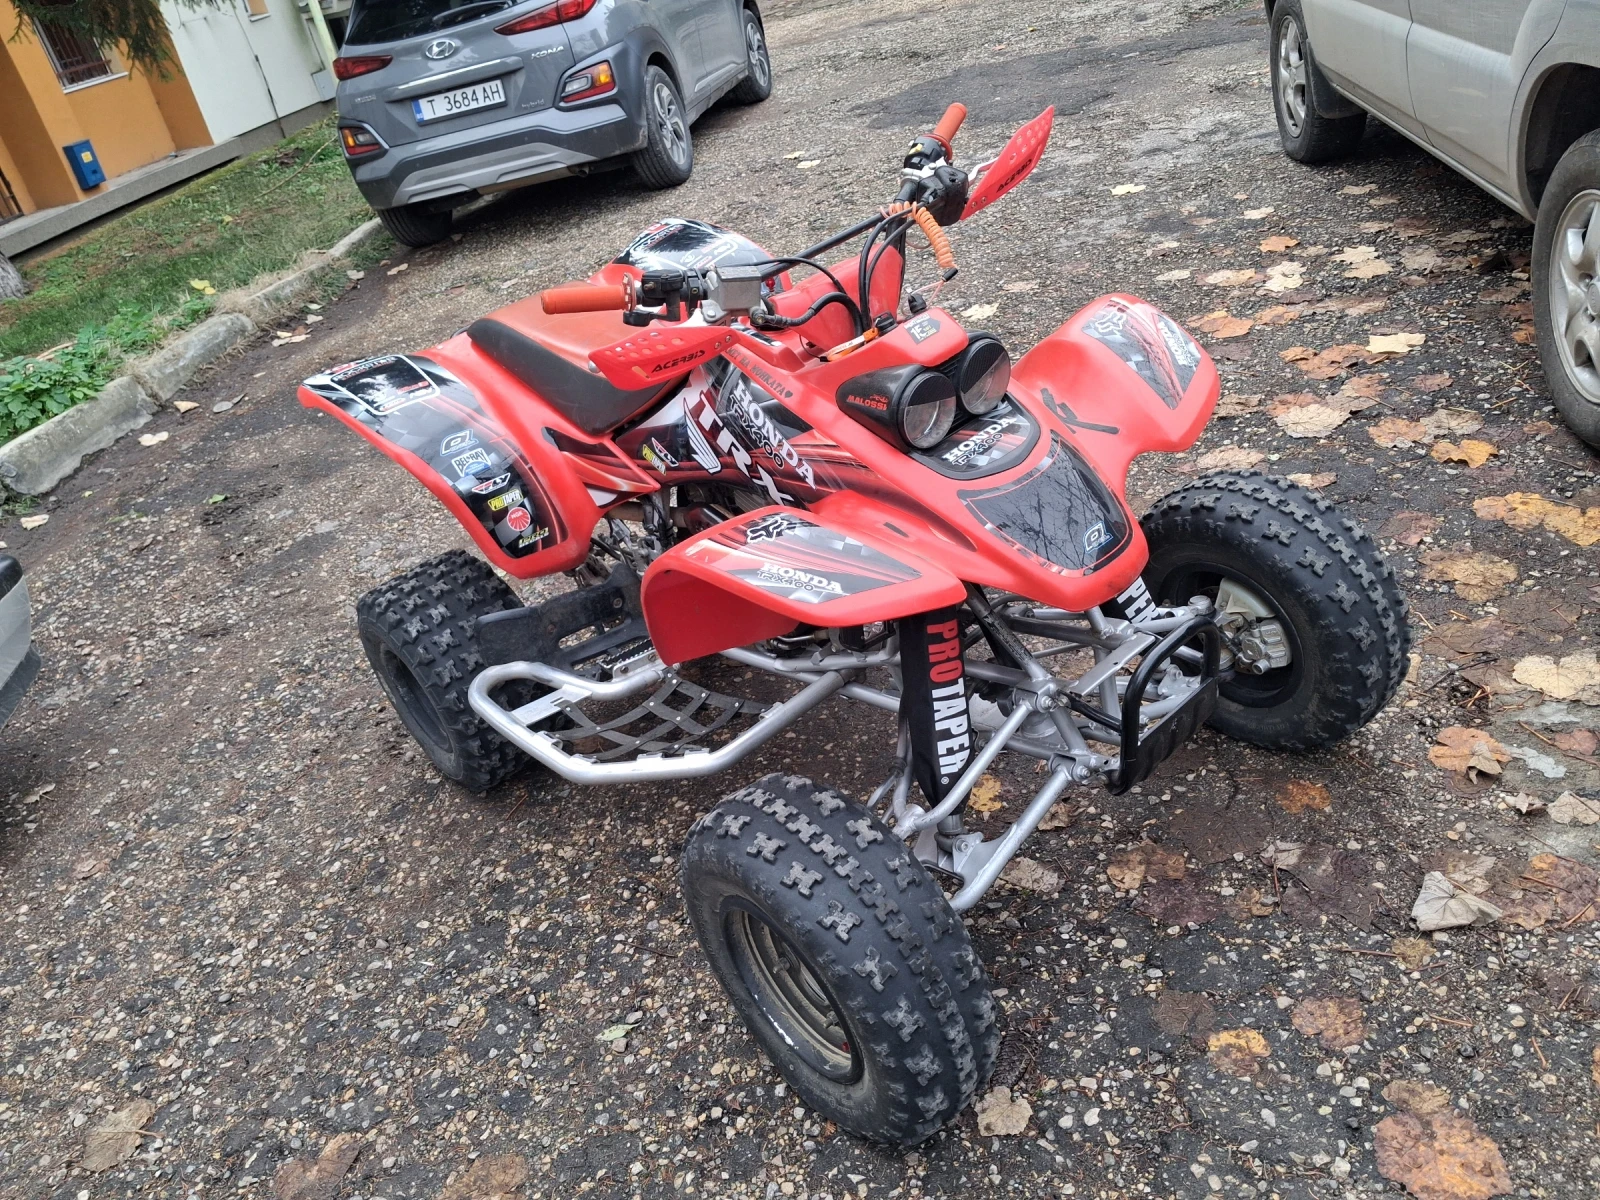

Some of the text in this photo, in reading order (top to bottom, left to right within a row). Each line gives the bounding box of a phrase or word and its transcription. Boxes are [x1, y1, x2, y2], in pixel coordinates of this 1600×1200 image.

[531, 46, 564, 59] KONA
[426, 99, 438, 116] T
[445, 91, 479, 112] 3684
[483, 84, 502, 104] AH
[651, 349, 706, 374] ACERBIS
[847, 395, 887, 410] MALOSSI
[730, 394, 785, 469] TRX400
[734, 380, 816, 490] HONDA
[942, 415, 1019, 462] HONDA
[698, 390, 794, 506] TRX
[952, 432, 1003, 466] TRX400
[489, 490, 522, 510] PROTAPER
[757, 570, 814, 592] TRX400
[759, 562, 843, 594] HONDA
[926, 618, 973, 776] PROTAPER
